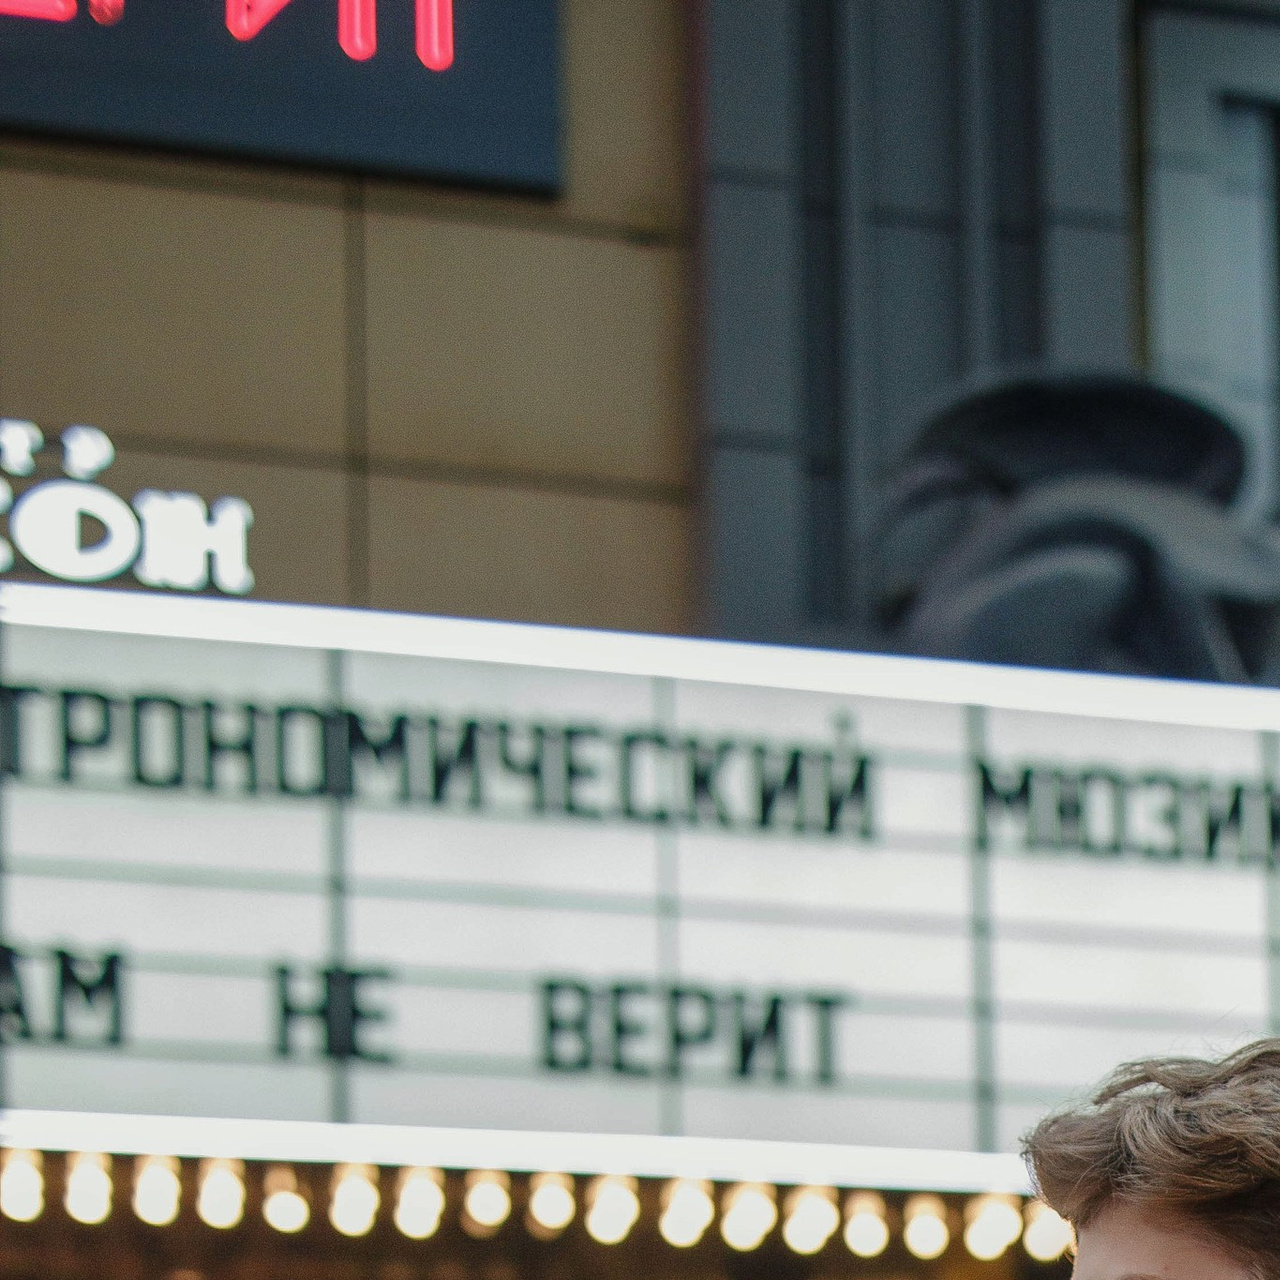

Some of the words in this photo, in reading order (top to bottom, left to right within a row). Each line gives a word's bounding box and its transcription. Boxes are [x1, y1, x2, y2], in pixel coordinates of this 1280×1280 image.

[0, 478, 255, 596] ОН
[0, 684, 877, 842] ТРОНОМИЧЕСКИЙ
[273, 962, 397, 1064] НЕ
[538, 976, 850, 1088] ВЕРИТ
